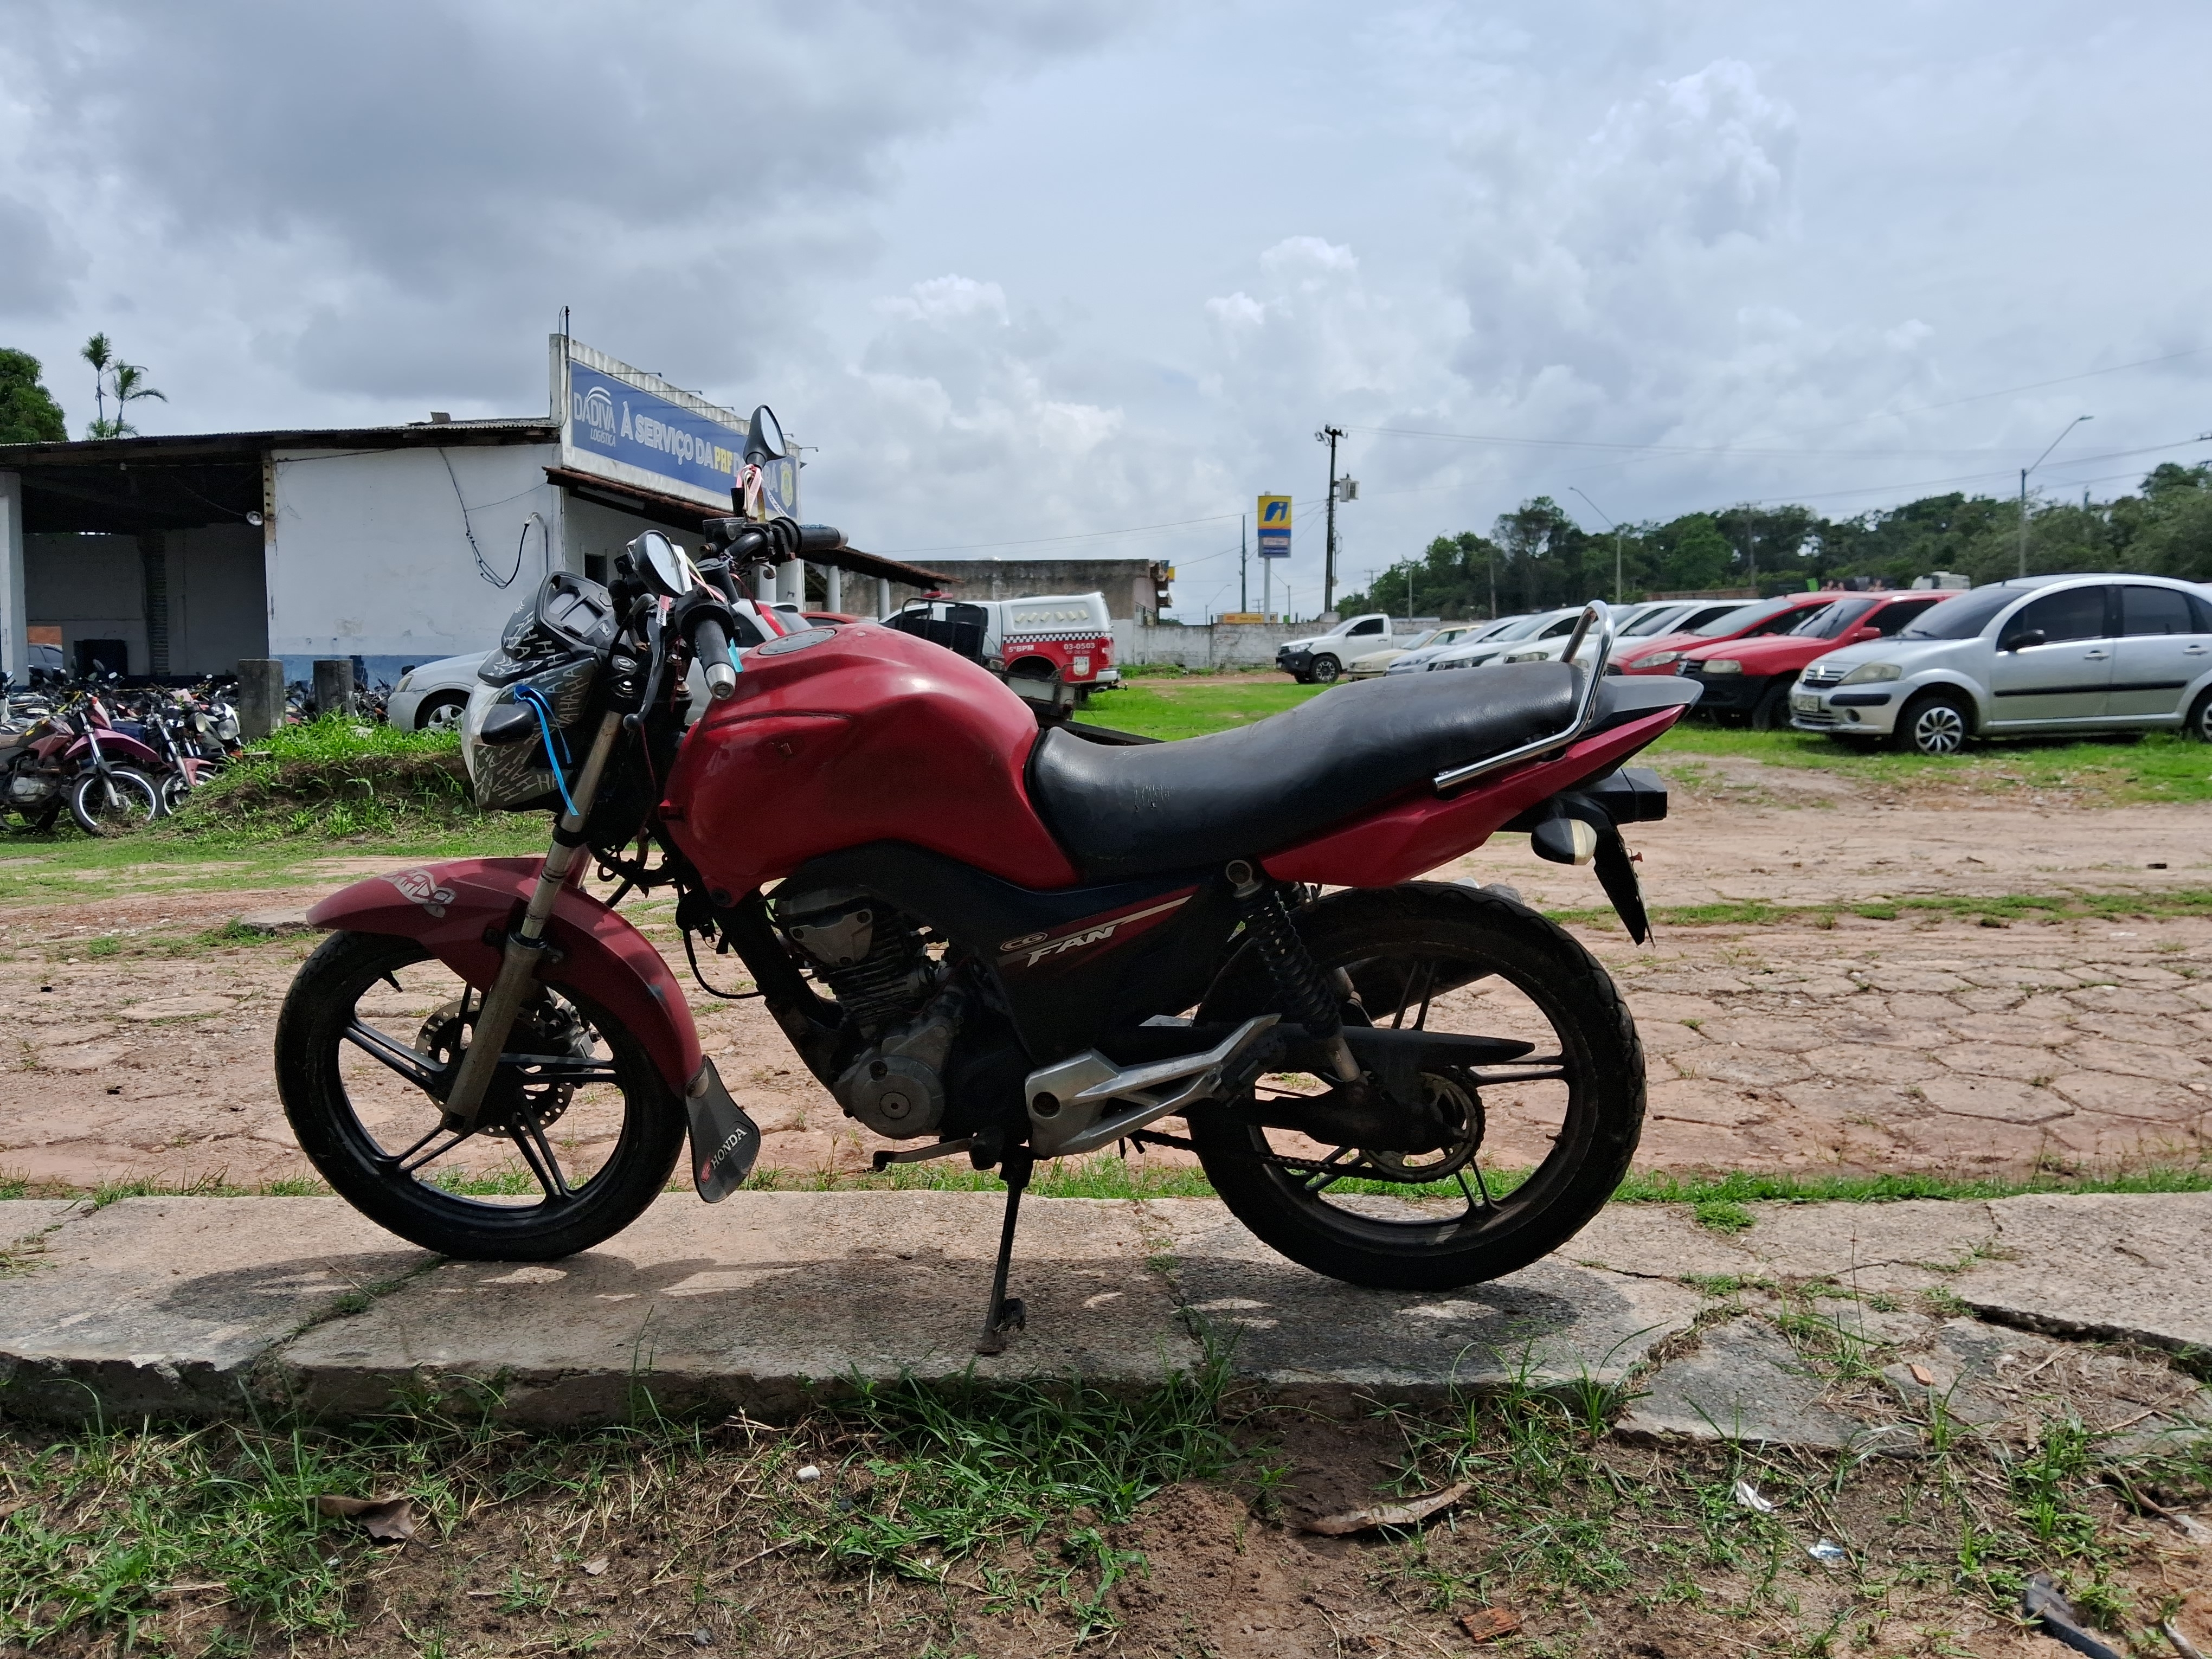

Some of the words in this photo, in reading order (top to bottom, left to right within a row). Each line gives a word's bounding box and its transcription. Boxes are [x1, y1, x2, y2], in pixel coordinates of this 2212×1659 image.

[574, 392, 616, 433] DADIVA
[620, 401, 634, 440] À
[635, 414, 694, 465] SERVIÇO
[695, 437, 714, 470] DA
[714, 446, 734, 474] PRF
[1004, 934, 1045, 950] CG
[1026, 924, 1117, 968] FAN
[710, 1127, 748, 1170] HONDA
